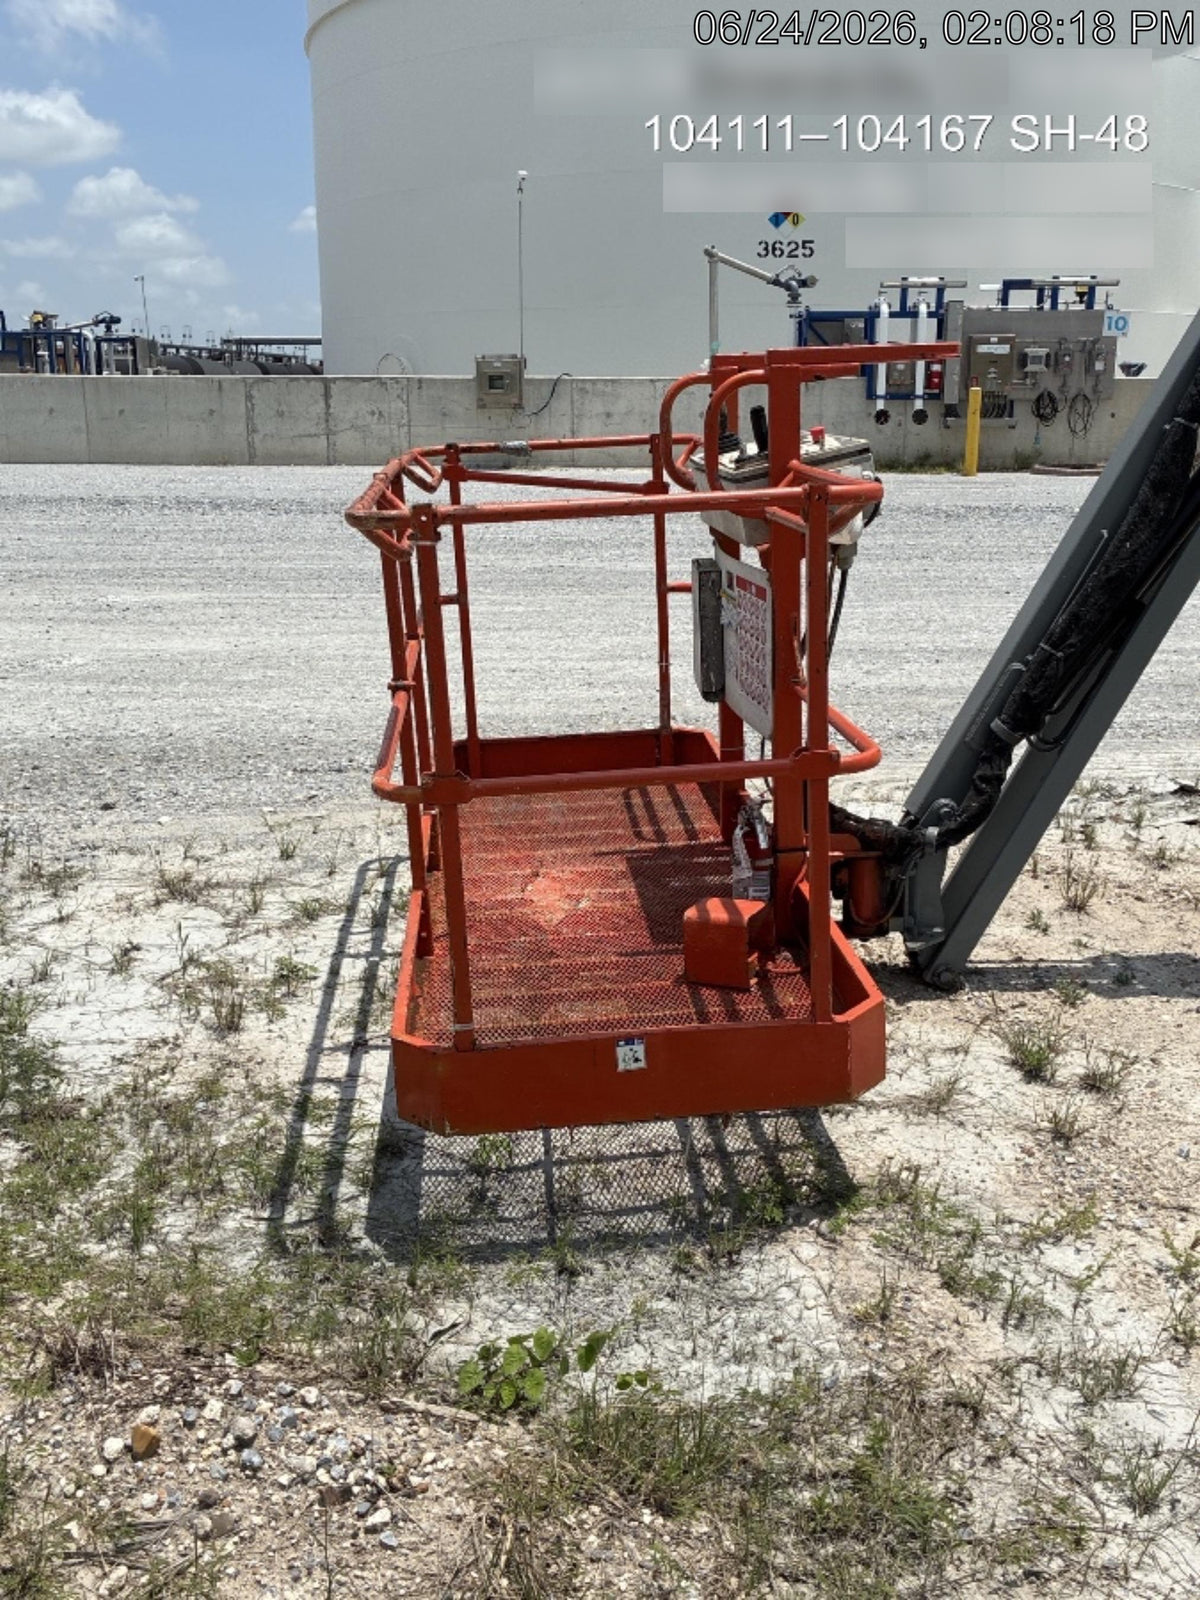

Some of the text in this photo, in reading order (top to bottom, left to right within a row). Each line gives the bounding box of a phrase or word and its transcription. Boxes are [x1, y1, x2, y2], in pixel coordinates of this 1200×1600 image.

[792, 212, 799, 226] 0
[757, 240, 815, 258] 3625
[1106, 315, 1127, 331] 10
